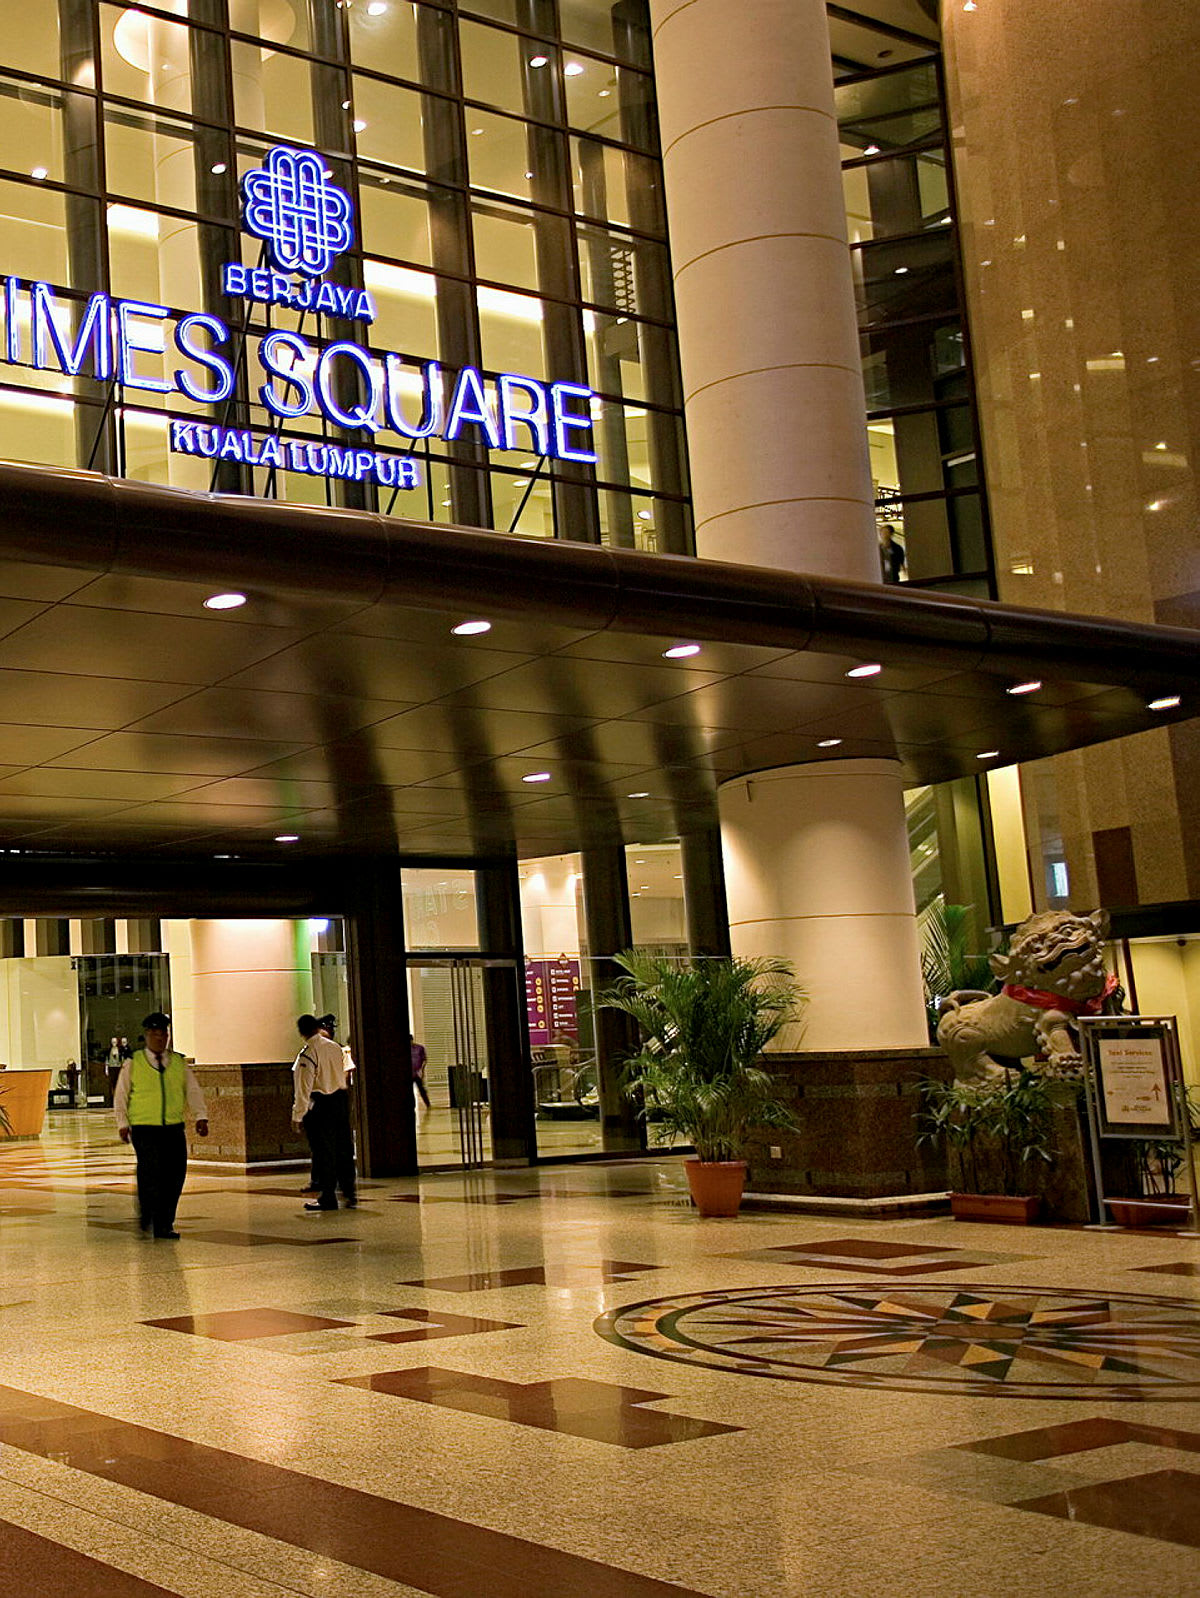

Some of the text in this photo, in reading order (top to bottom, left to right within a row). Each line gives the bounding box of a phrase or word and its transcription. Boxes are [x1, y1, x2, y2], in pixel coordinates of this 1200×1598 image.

[222, 262, 377, 323] BERJAYA
[258, 329, 598, 464] SQUARE
[170, 420, 419, 490] KUALA LUMPUR
